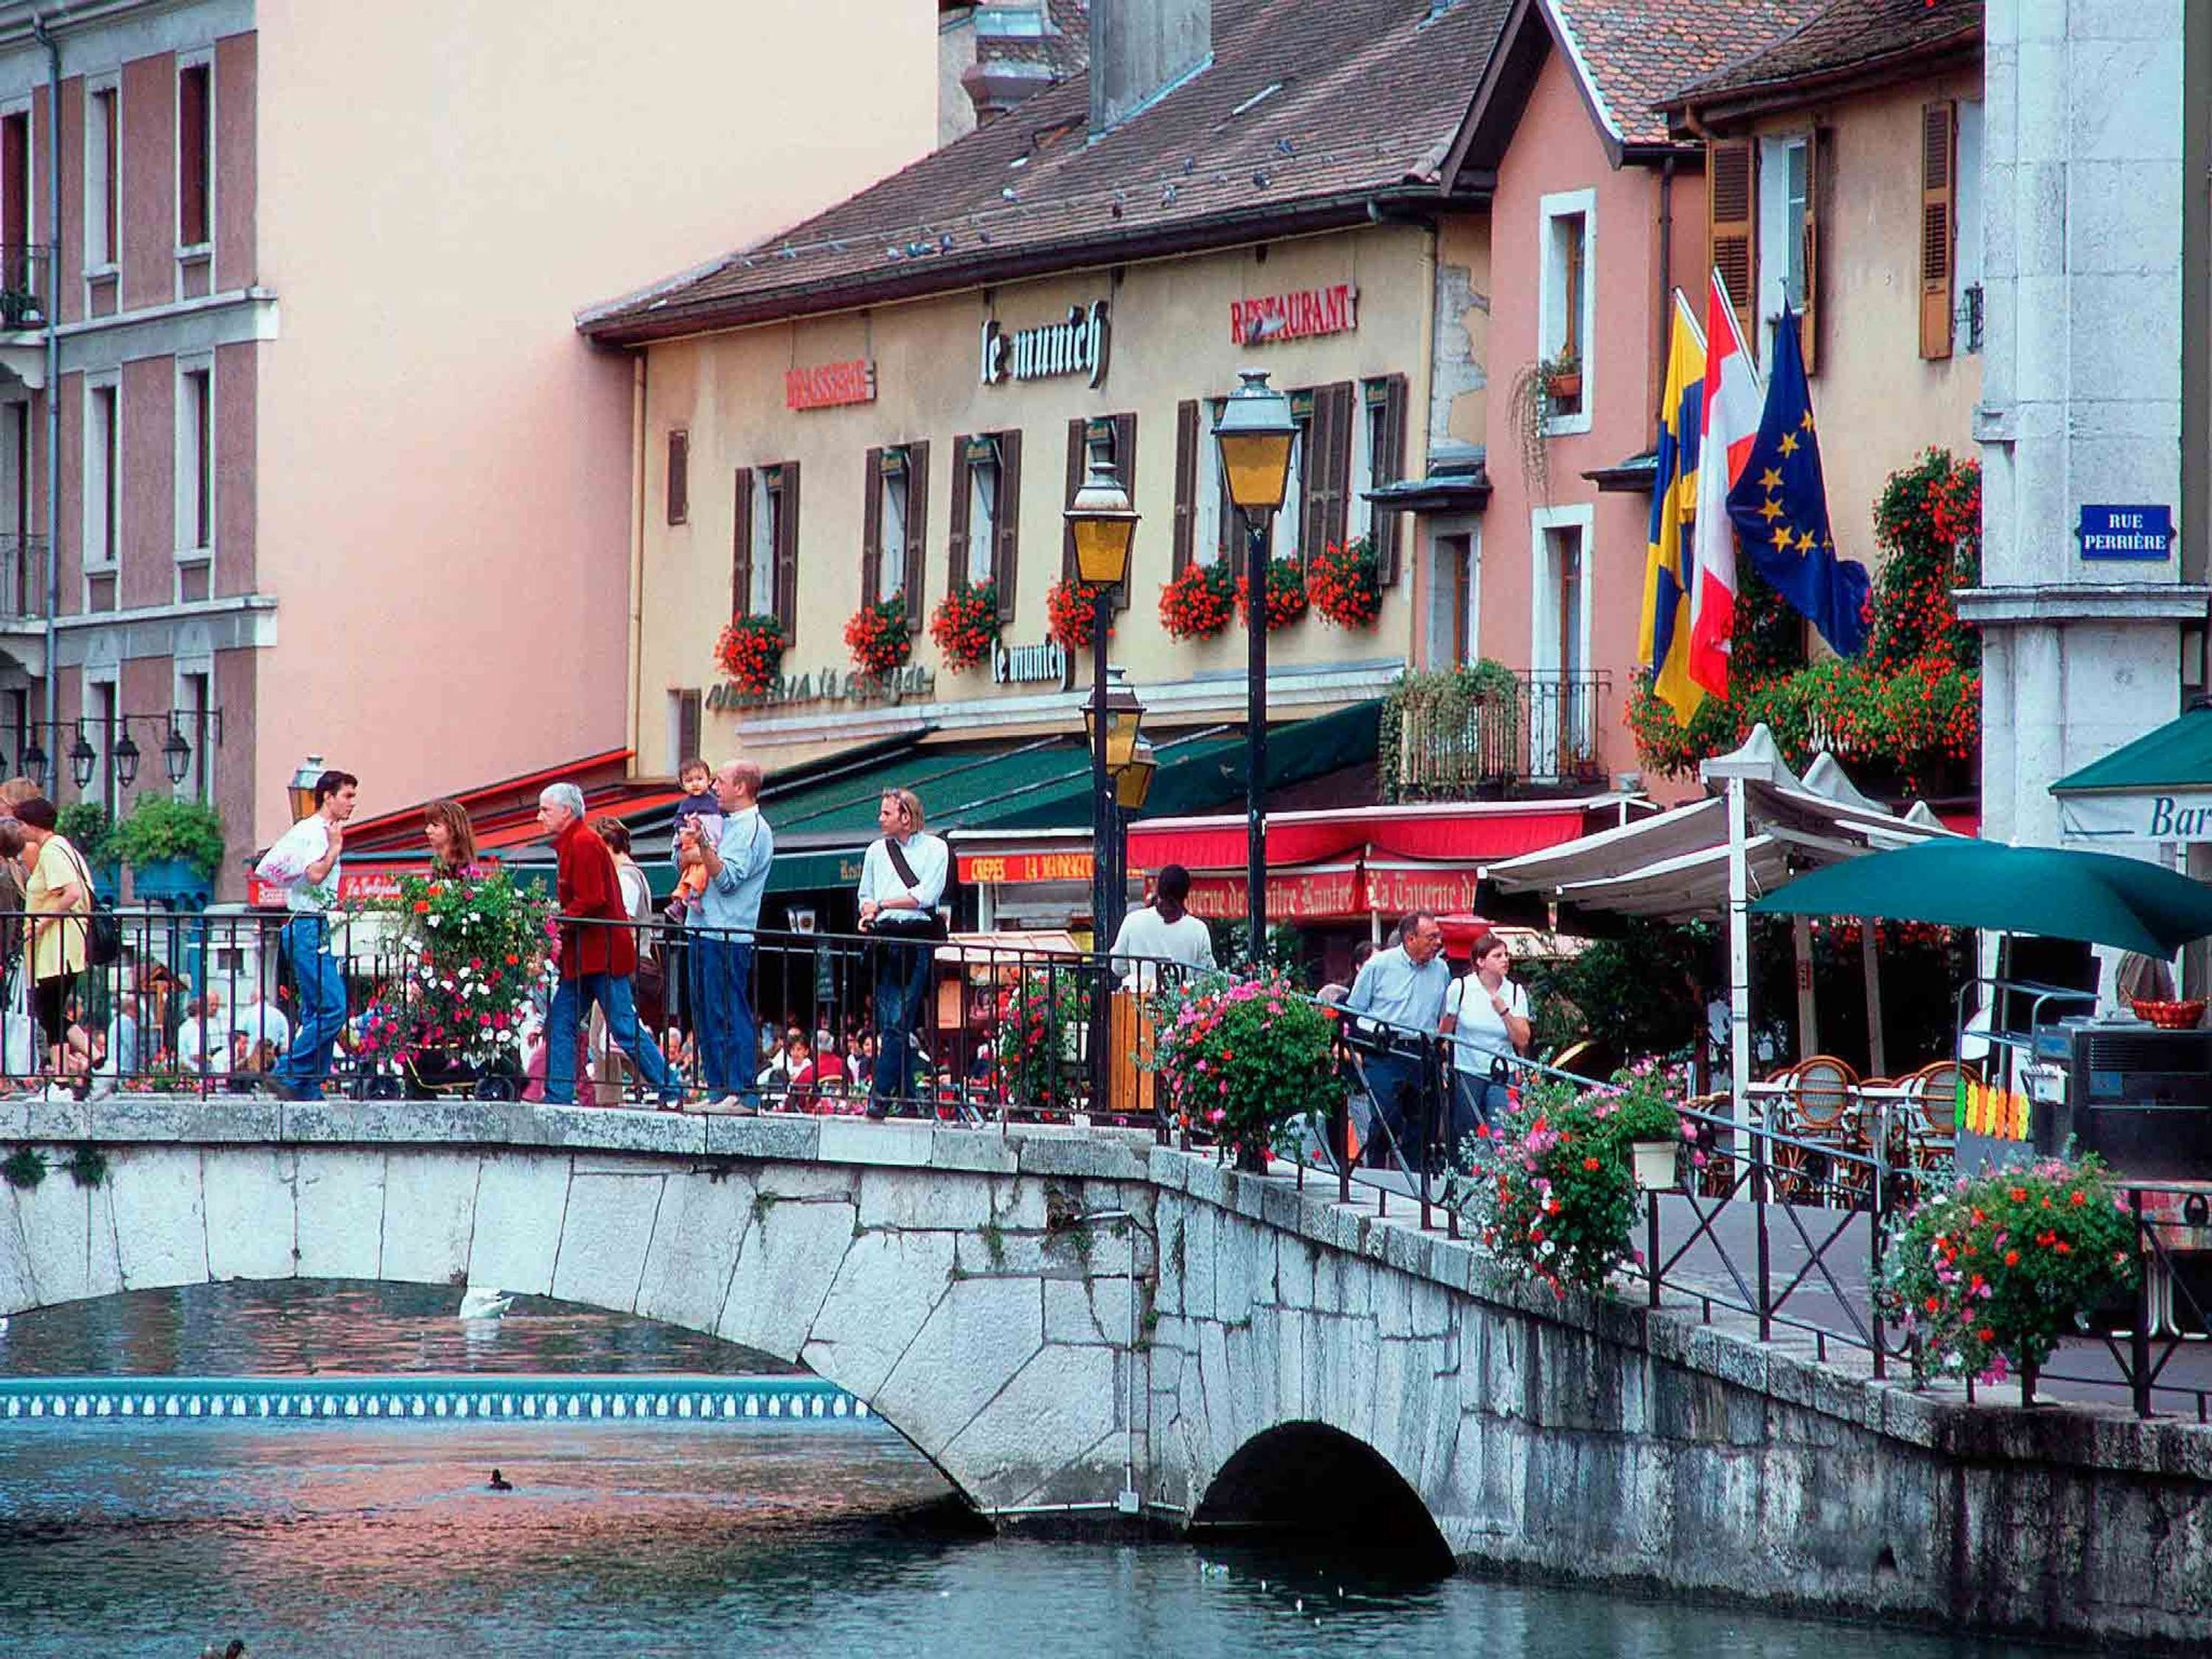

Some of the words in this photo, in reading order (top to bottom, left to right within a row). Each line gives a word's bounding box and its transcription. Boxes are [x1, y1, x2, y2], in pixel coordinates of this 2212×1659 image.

[2109, 514, 2143, 529] RUE
[2084, 531, 2166, 550] PERRIÈRE
[2149, 796, 2212, 837] Bar
